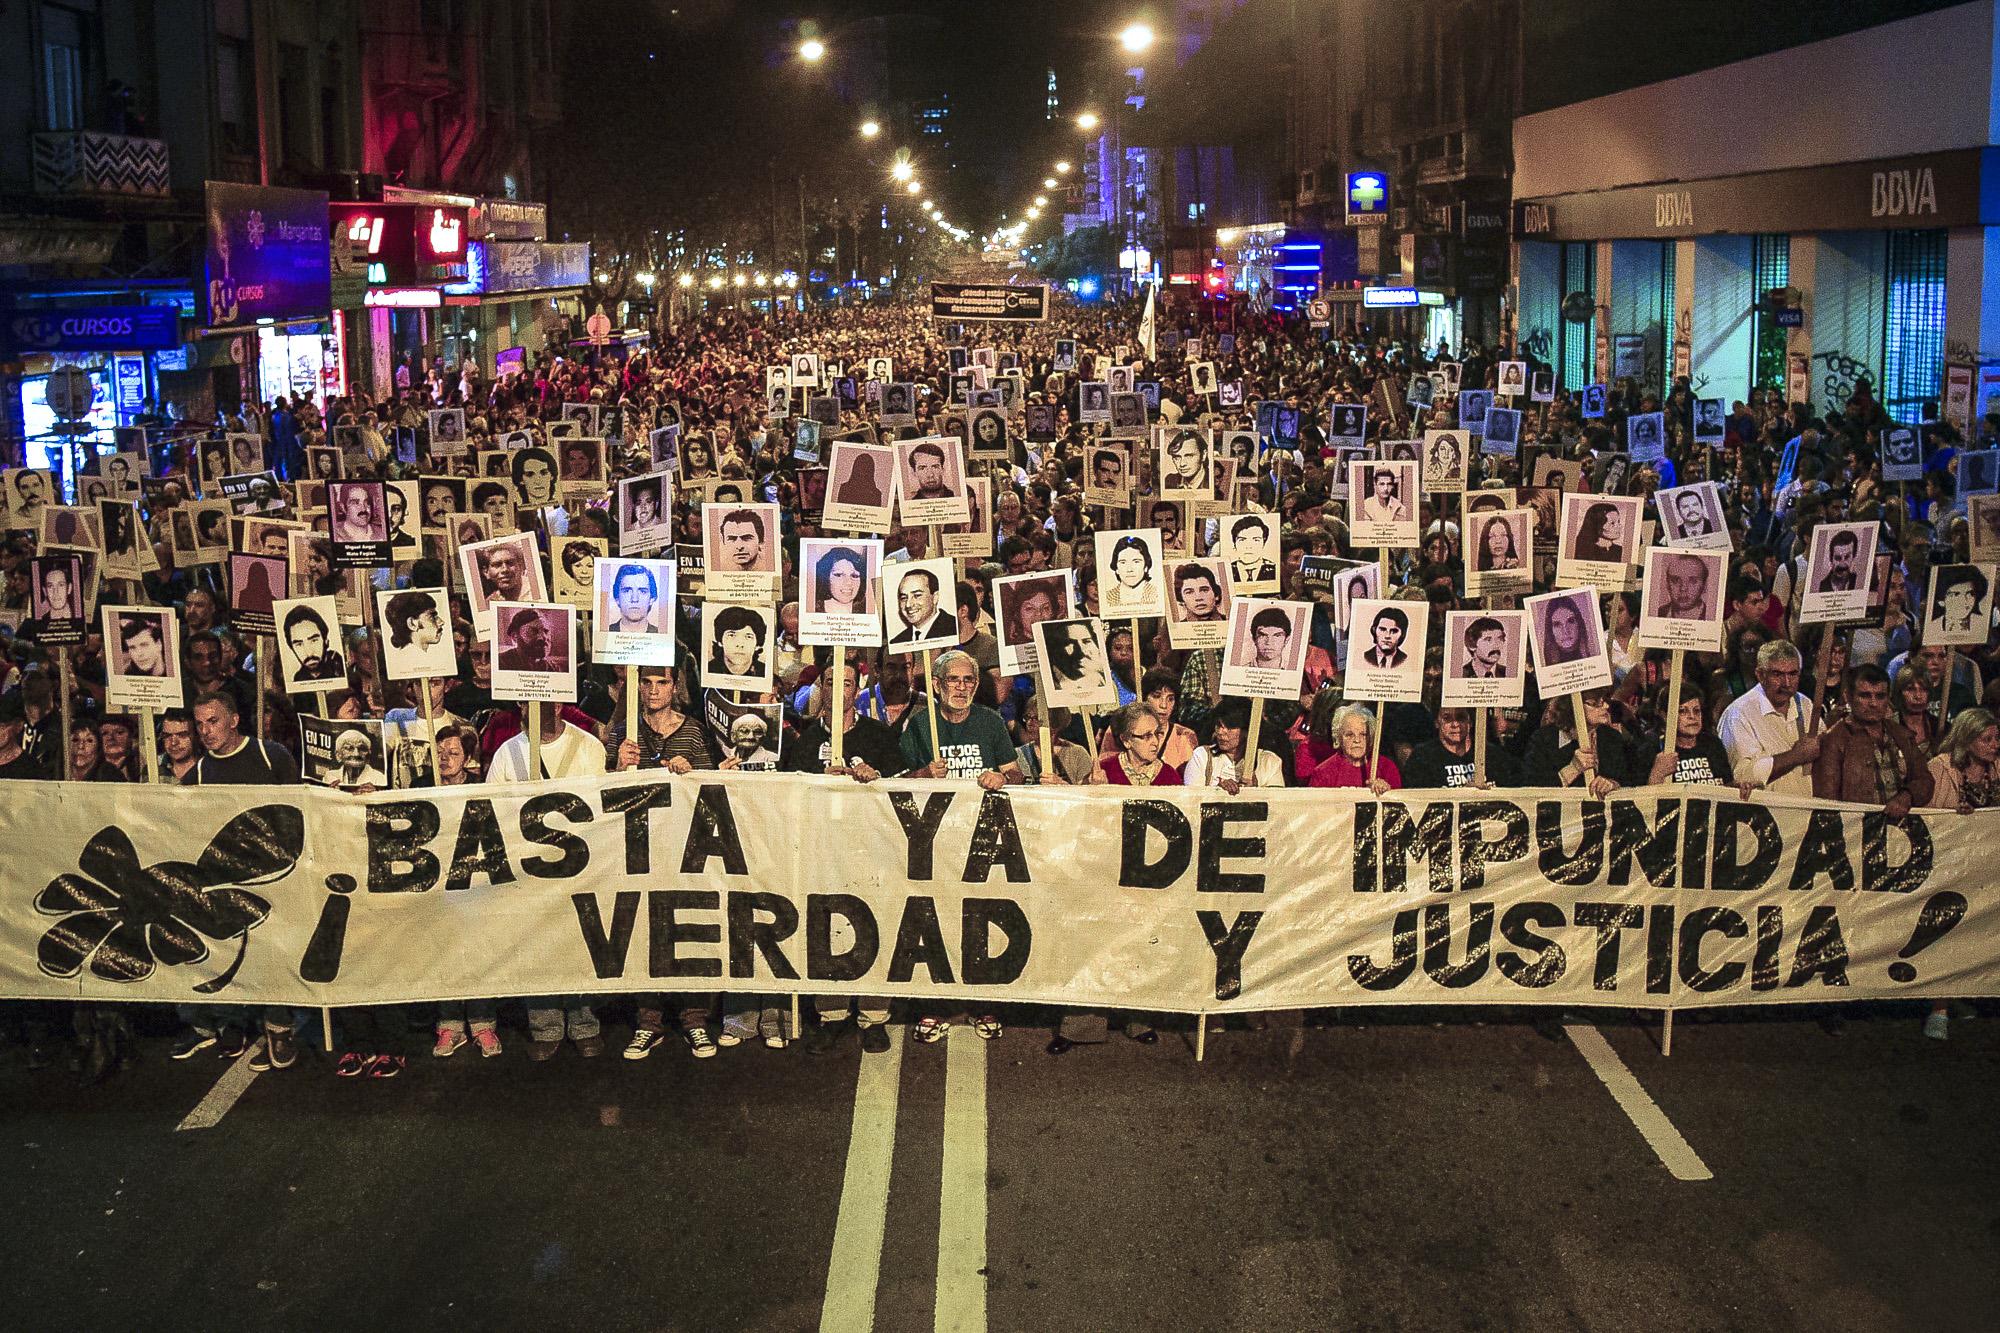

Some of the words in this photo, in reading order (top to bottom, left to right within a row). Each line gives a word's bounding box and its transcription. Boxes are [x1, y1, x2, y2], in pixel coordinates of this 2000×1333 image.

[1871, 167, 1937, 217] BBVA
[1524, 204, 1550, 233] BBVA
[1655, 191, 1694, 228] BBVA
[1468, 215, 1503, 228] BBVA
[61, 317, 133, 336] CURSOS
[1778, 312, 1801, 324] VISA
[680, 556, 693, 567] EN
[1304, 567, 1317, 578] EN
[1320, 569, 1332, 581] TU
[707, 700, 718, 718] EN
[719, 709, 729, 727] TU
[305, 729, 318, 745] EN
[319, 733, 331, 749] TU
[946, 755, 984, 770] OMOS
[1674, 768, 1714, 782] SOMOS
[887, 789, 1032, 884] YA
[1118, 799, 1269, 894] DE
[1352, 797, 1936, 894] IMPUNIDAD
[570, 890, 1033, 985] VERDAD
[1196, 910, 1264, 1001] Y
